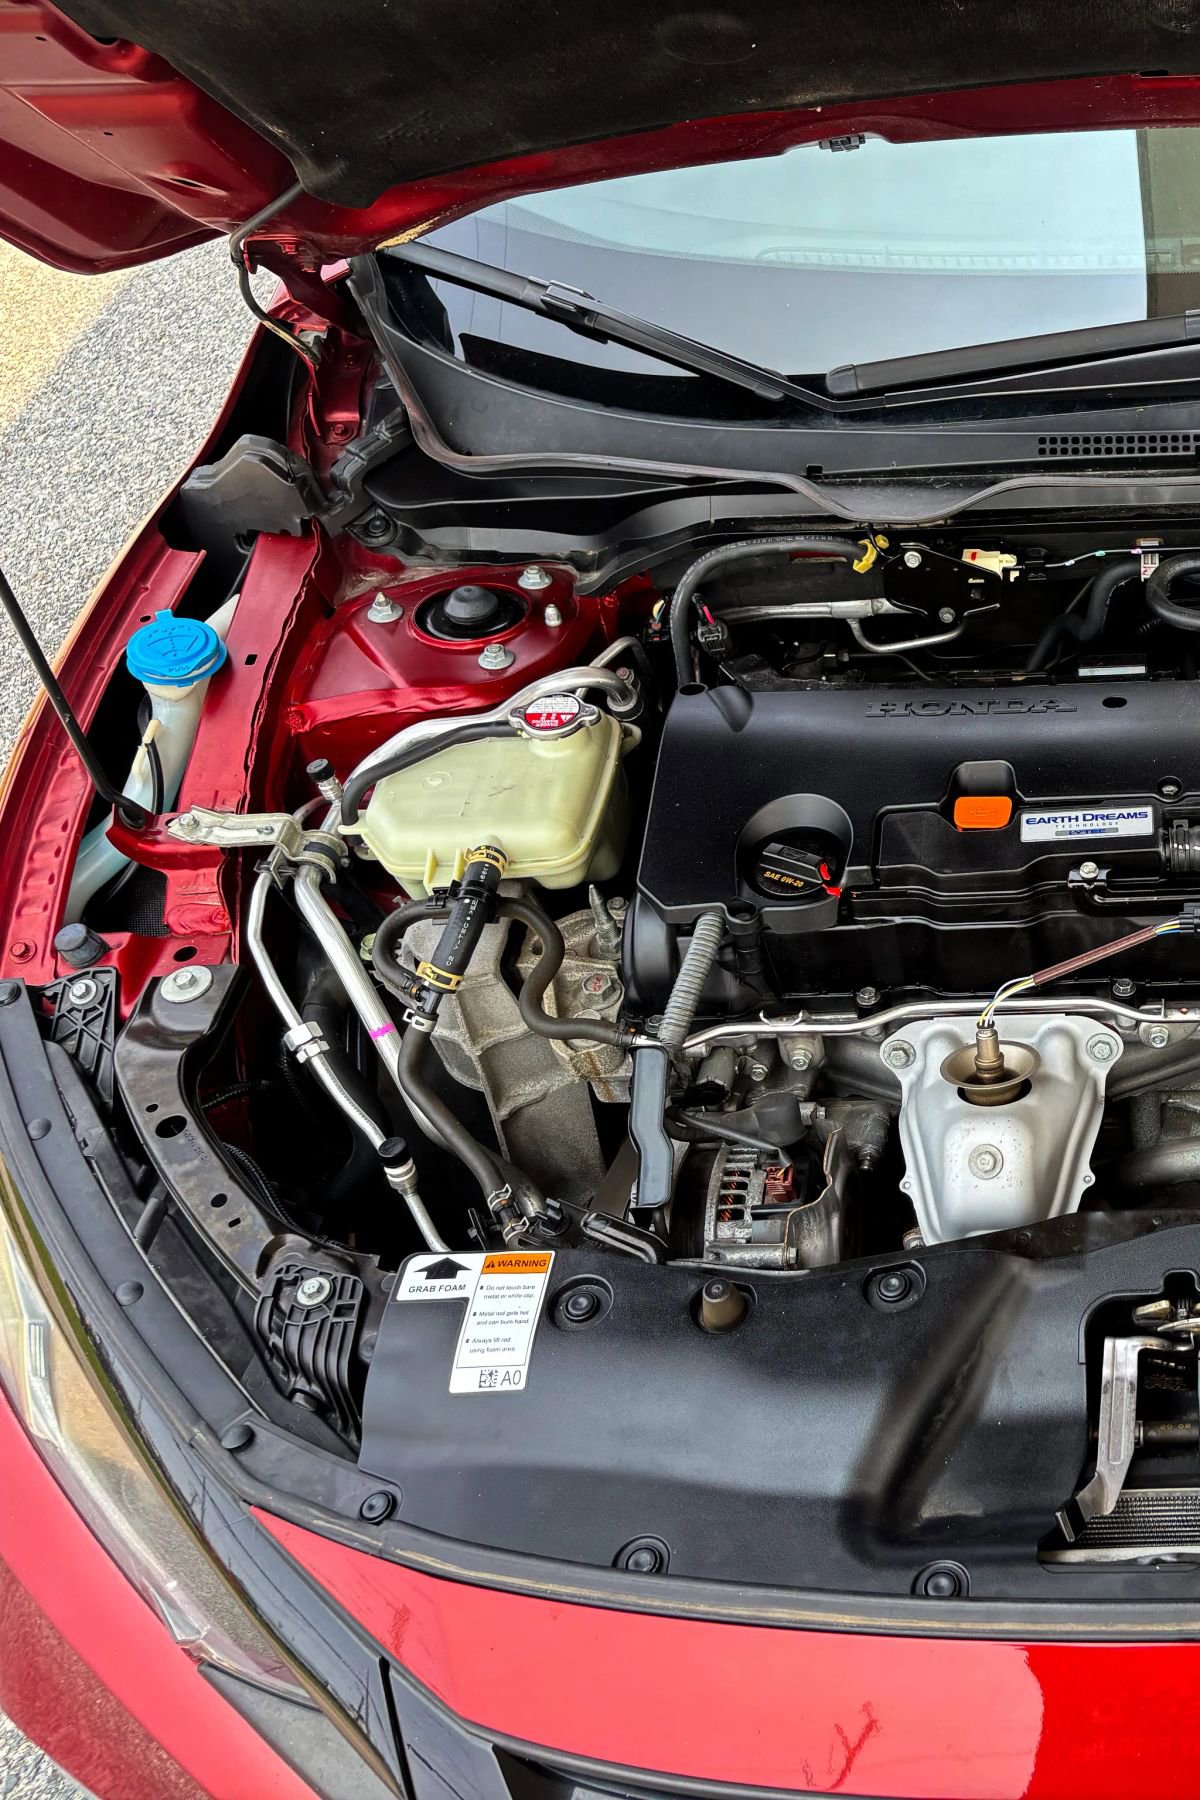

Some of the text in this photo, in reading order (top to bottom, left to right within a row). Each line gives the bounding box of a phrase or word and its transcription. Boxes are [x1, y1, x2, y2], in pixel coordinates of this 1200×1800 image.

[865, 698, 1078, 717] HONDA
[1025, 811, 1148, 825] EARTH DREAMS
[1055, 821, 1119, 829] TECHNOLOGY
[763, 871, 804, 887] SAE 0W-20
[497, 1259, 547, 1268] WARNING
[408, 1284, 467, 1293] GRAB FOAM
[500, 1369, 522, 1386] A0
